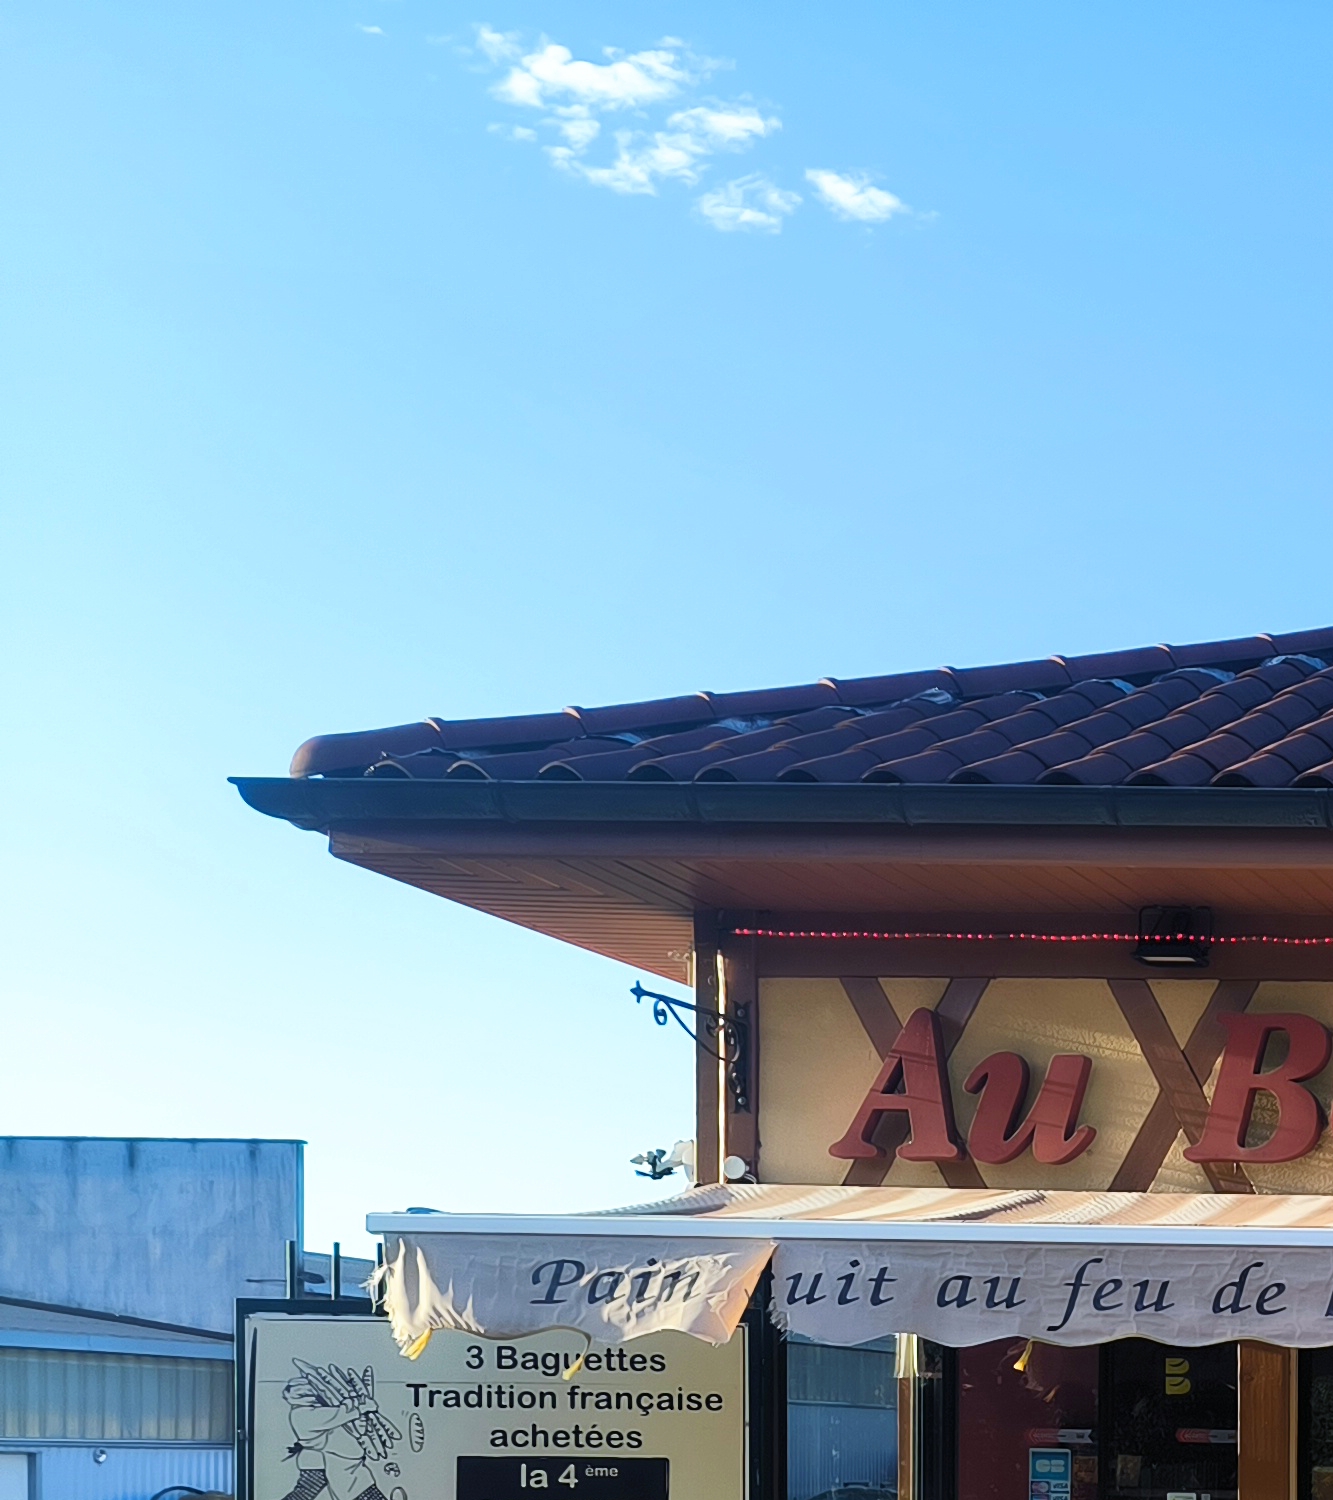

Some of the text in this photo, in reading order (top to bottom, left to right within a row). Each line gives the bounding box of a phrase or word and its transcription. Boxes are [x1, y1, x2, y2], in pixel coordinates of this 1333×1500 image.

[828, 1005, 1096, 1165] Au
[530, 1257, 701, 1305] Pain
[784, 1259, 897, 1306] uit
[936, 1274, 1026, 1309] au
[1047, 1258, 1174, 1331] feu
[1212, 1261, 1288, 1316] de
[465, 1346, 667, 1378] 3 Baguettes
[406, 1384, 724, 1417] Tradition française
[489, 1424, 644, 1450] achetées
[520, 1463, 619, 1489] la 4 ème
